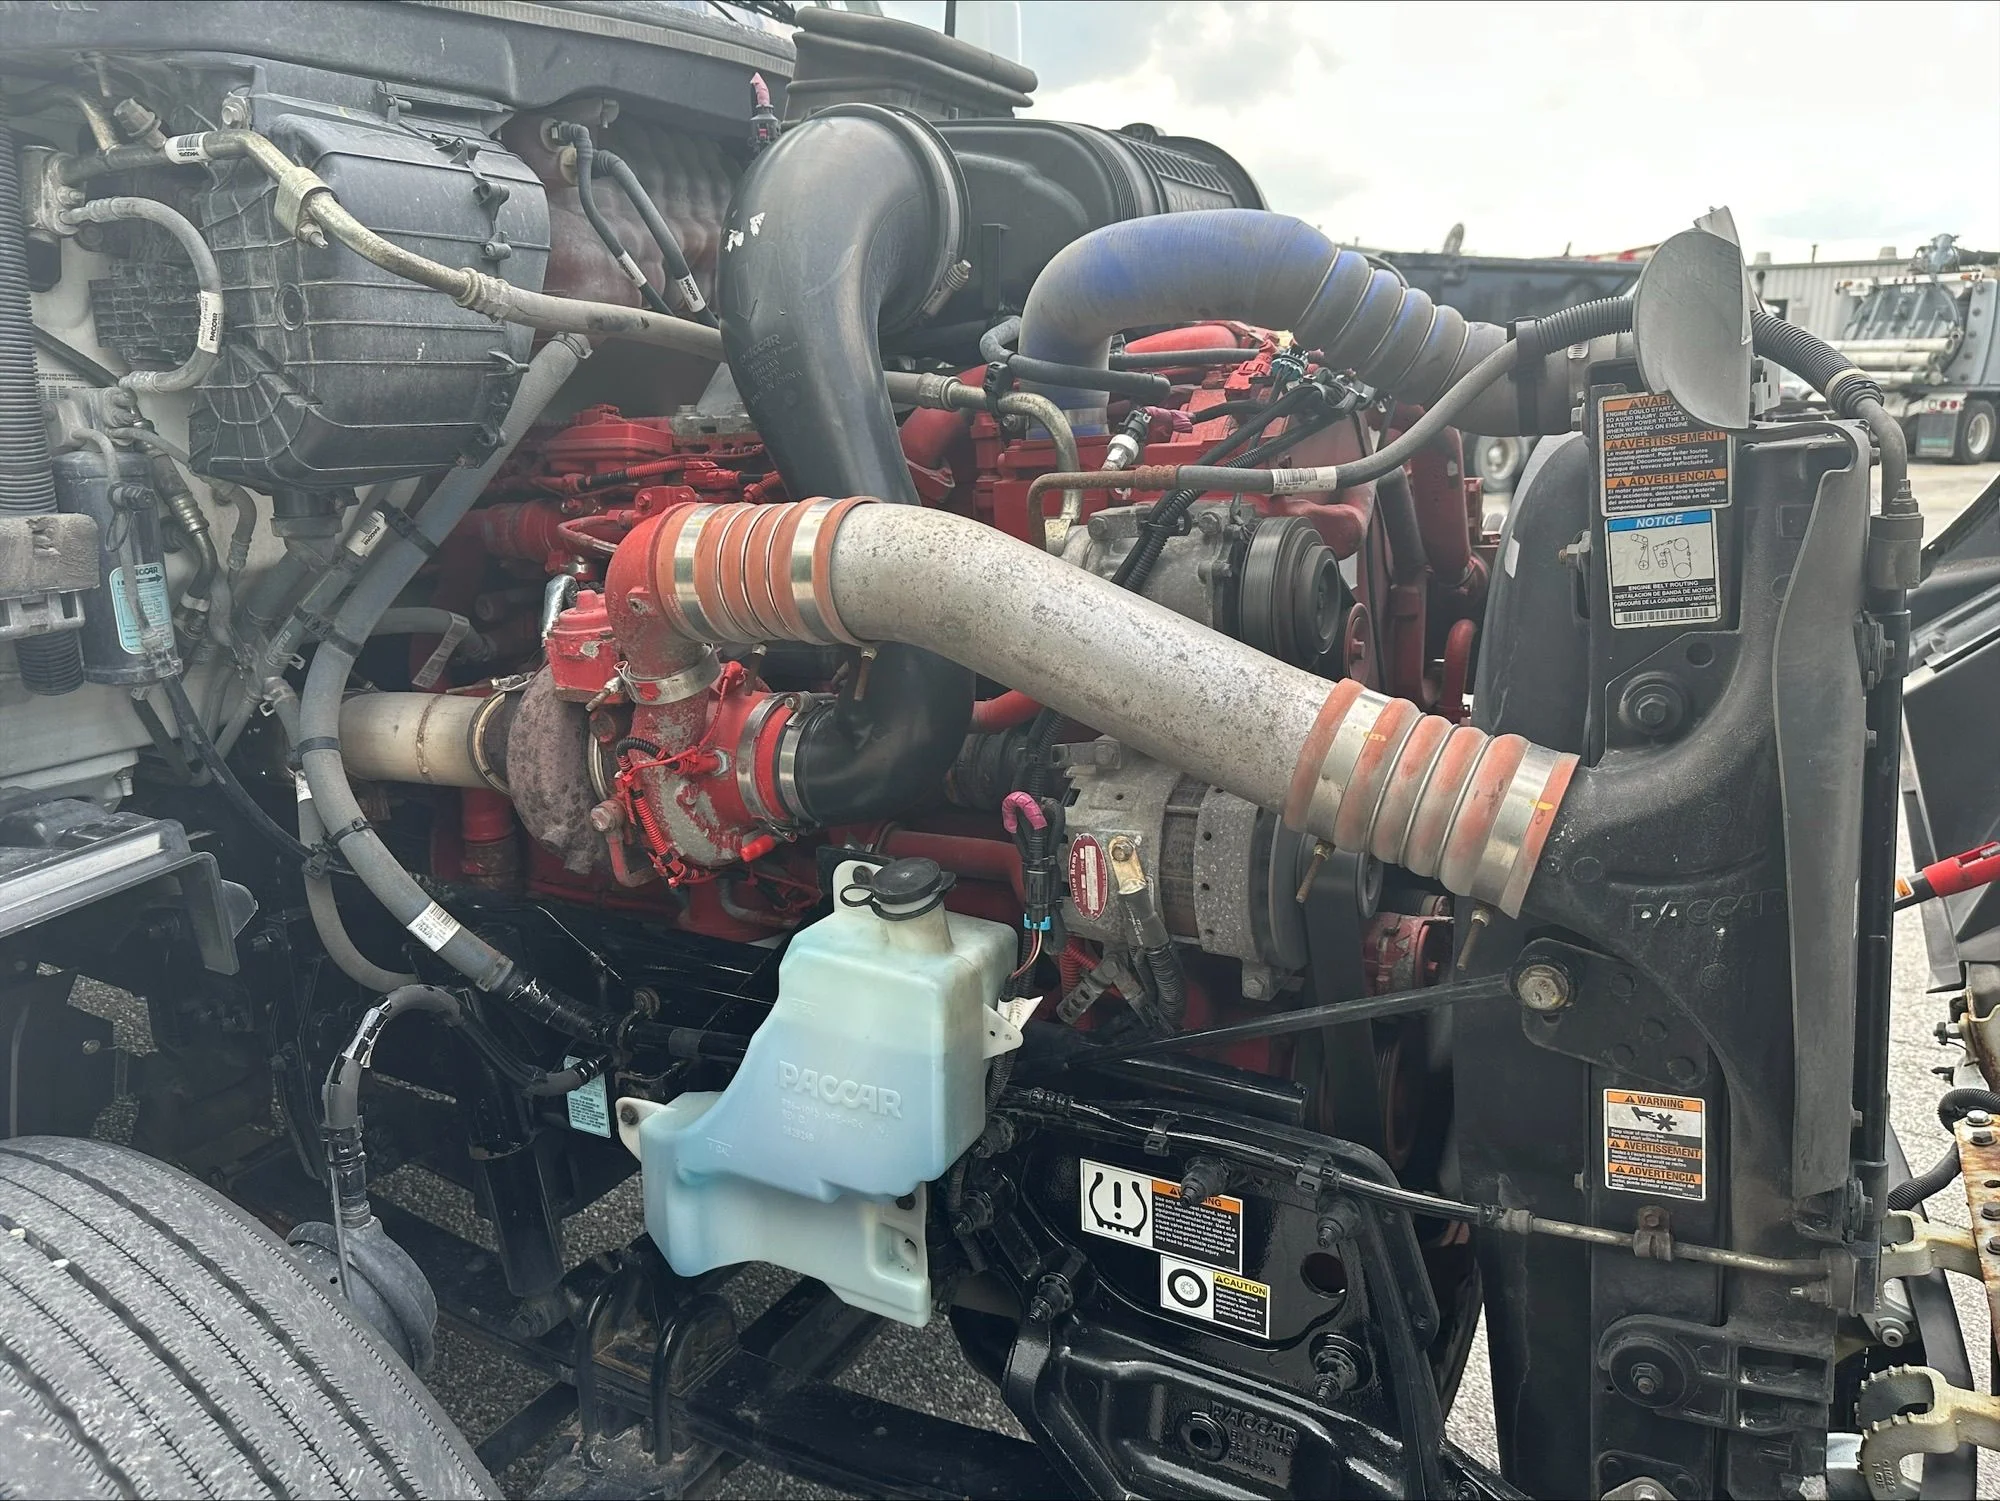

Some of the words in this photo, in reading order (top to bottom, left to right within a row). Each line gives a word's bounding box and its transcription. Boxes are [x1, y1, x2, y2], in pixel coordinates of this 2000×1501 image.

[209, 312, 218, 342] PACCAR
[1625, 424, 1653, 432] WORKING
[1619, 431, 1719, 448] AVERTISSEMENT
[1628, 470, 1716, 485] ADVERTENCIA
[1635, 514, 1683, 527] NOTICE
[1070, 851, 1079, 875] Remy
[1071, 879, 1081, 904] Delco
[778, 1060, 902, 1119] PACCAR
[1637, 1096, 1683, 1108] WARNING
[1623, 1141, 1699, 1157] AVERTISSEMENT
[1628, 1166, 1695, 1181] ADVERTENCIA
[1223, 1277, 1265, 1295] CAUTION
[1211, 1401, 1298, 1448] PACCAR
